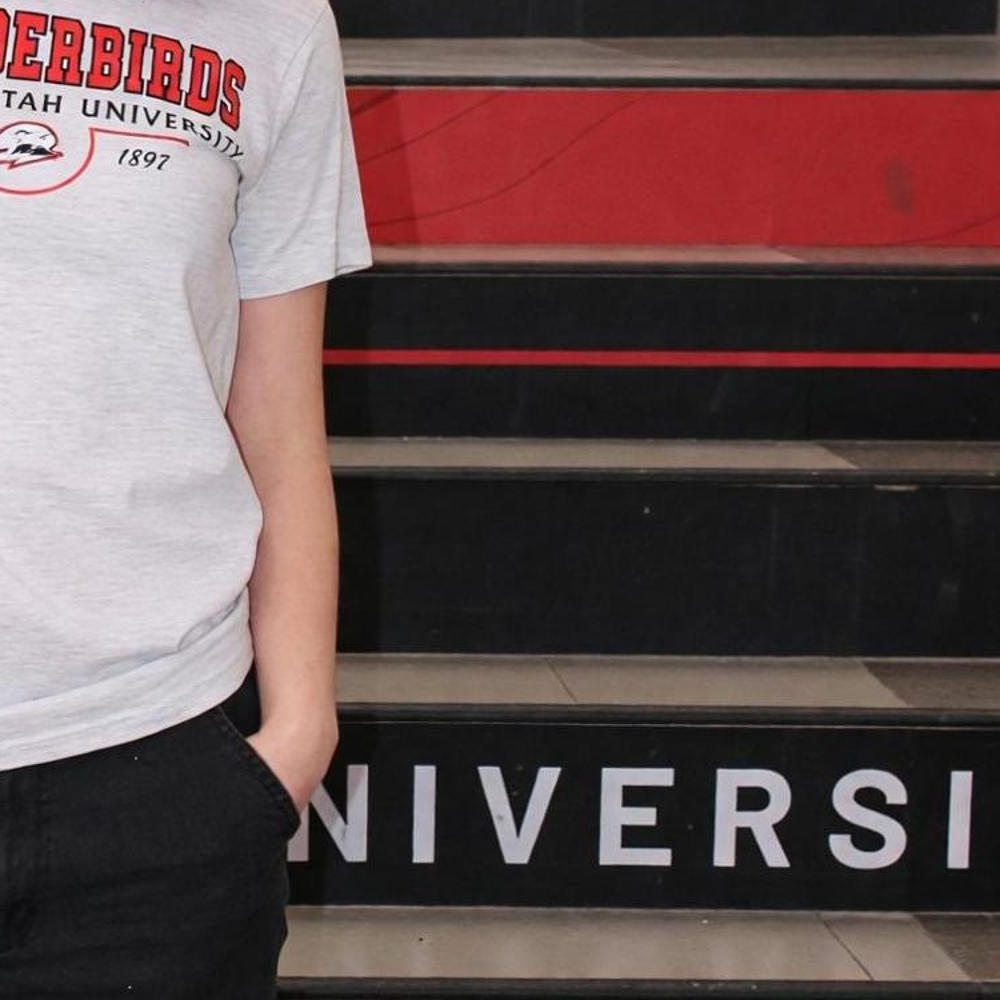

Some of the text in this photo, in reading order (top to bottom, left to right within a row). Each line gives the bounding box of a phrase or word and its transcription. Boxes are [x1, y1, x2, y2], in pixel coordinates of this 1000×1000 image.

[81, 99, 245, 159] UNIVERSITY
[118, 148, 171, 171] 1897
[286, 764, 974, 870] NIVERSI
